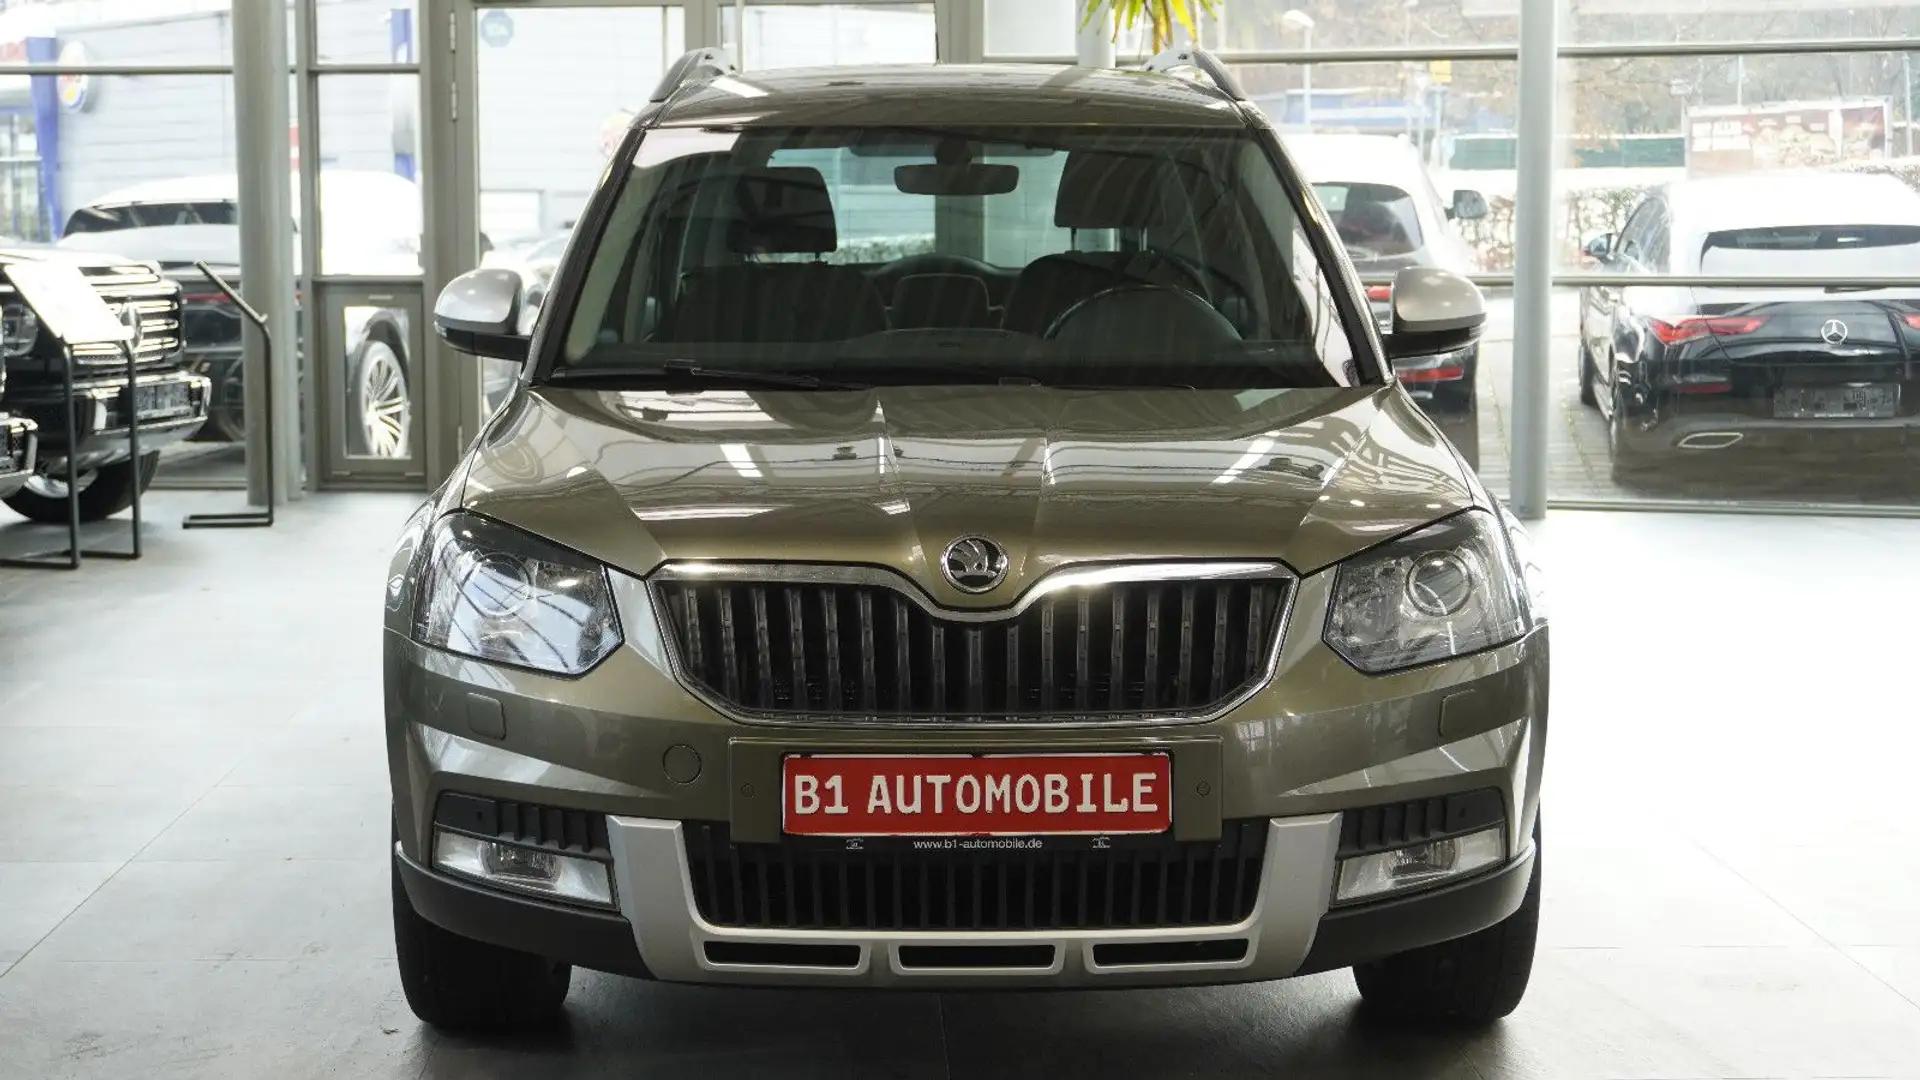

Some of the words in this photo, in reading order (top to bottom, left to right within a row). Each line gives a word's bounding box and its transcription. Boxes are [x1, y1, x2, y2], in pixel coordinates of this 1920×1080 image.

[794, 774, 849, 815] B1
[866, 772, 1159, 814] AUTOMOBILE
[913, 838, 1043, 849] www.b1-automobile.de
